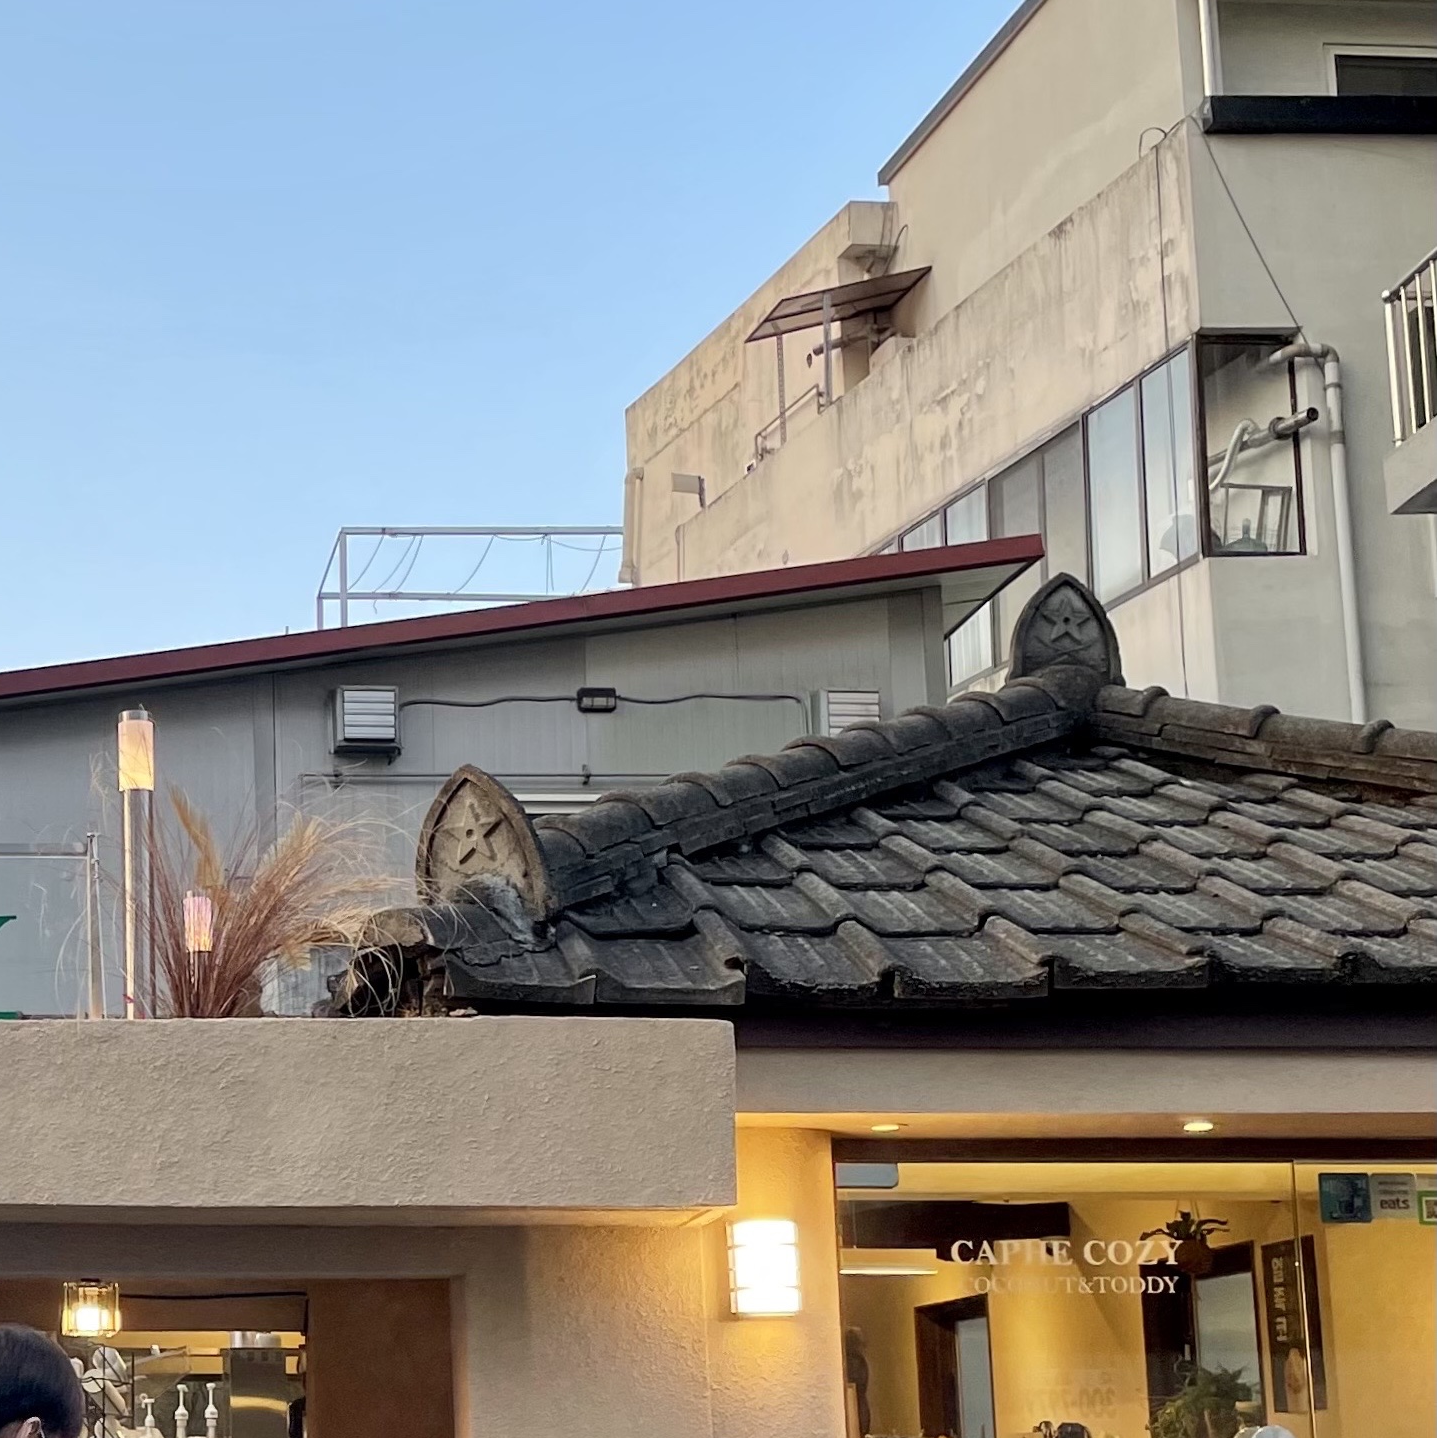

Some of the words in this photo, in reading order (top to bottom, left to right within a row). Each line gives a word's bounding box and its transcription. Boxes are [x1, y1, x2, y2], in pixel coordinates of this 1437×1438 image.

[1379, 1197, 1410, 1210] eats
[950, 1239, 1073, 1266] CAPHE
[1083, 1240, 1183, 1266] COZY
